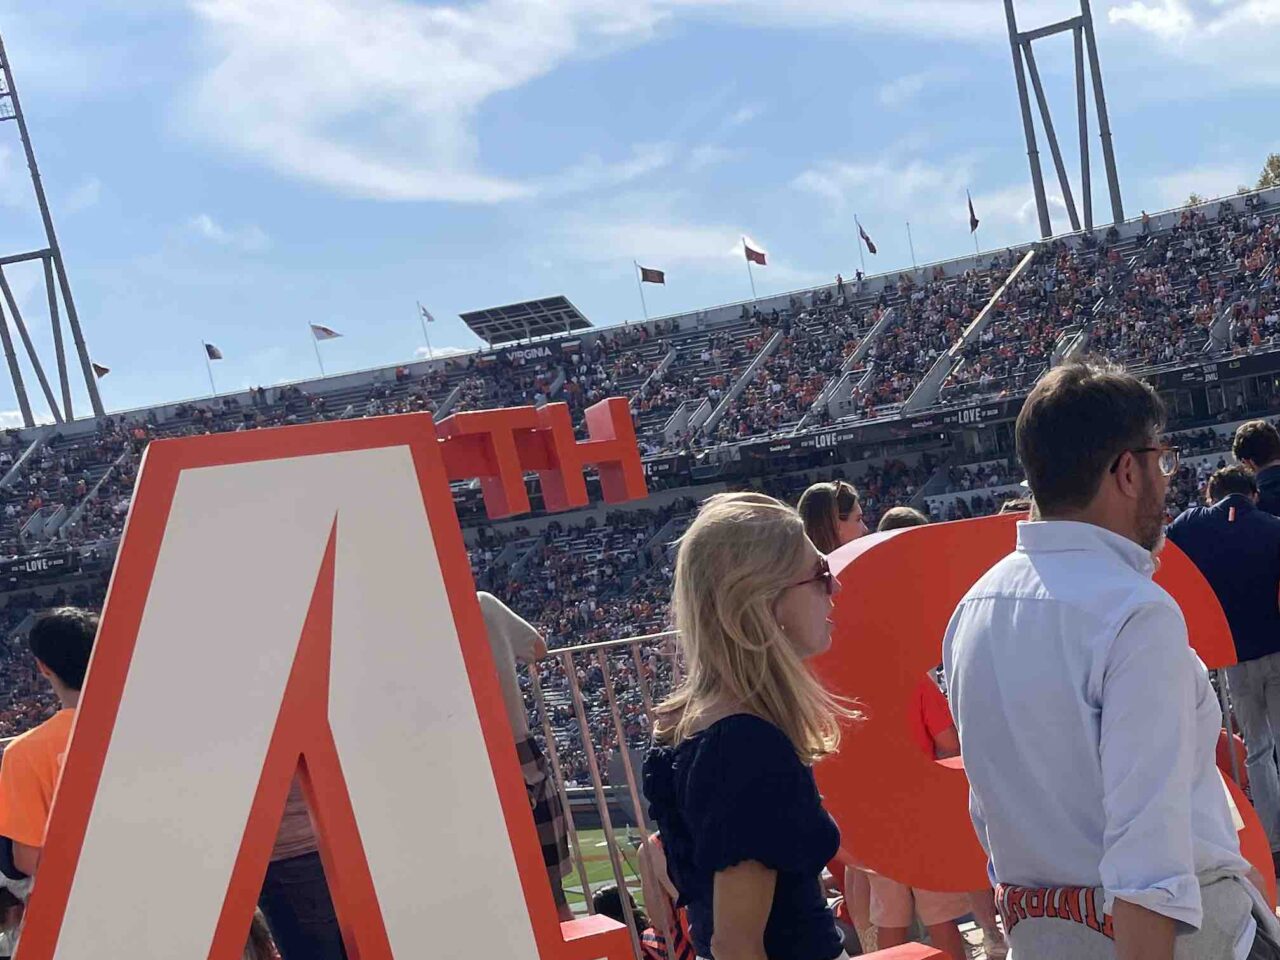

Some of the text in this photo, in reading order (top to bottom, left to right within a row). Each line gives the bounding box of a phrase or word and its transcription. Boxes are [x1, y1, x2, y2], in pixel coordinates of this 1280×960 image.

[506, 346, 552, 361] VIRGINIA
[958, 408, 982, 424] LOVE
[815, 433, 838, 449] LOVE
[26, 559, 49, 572] LOVE
